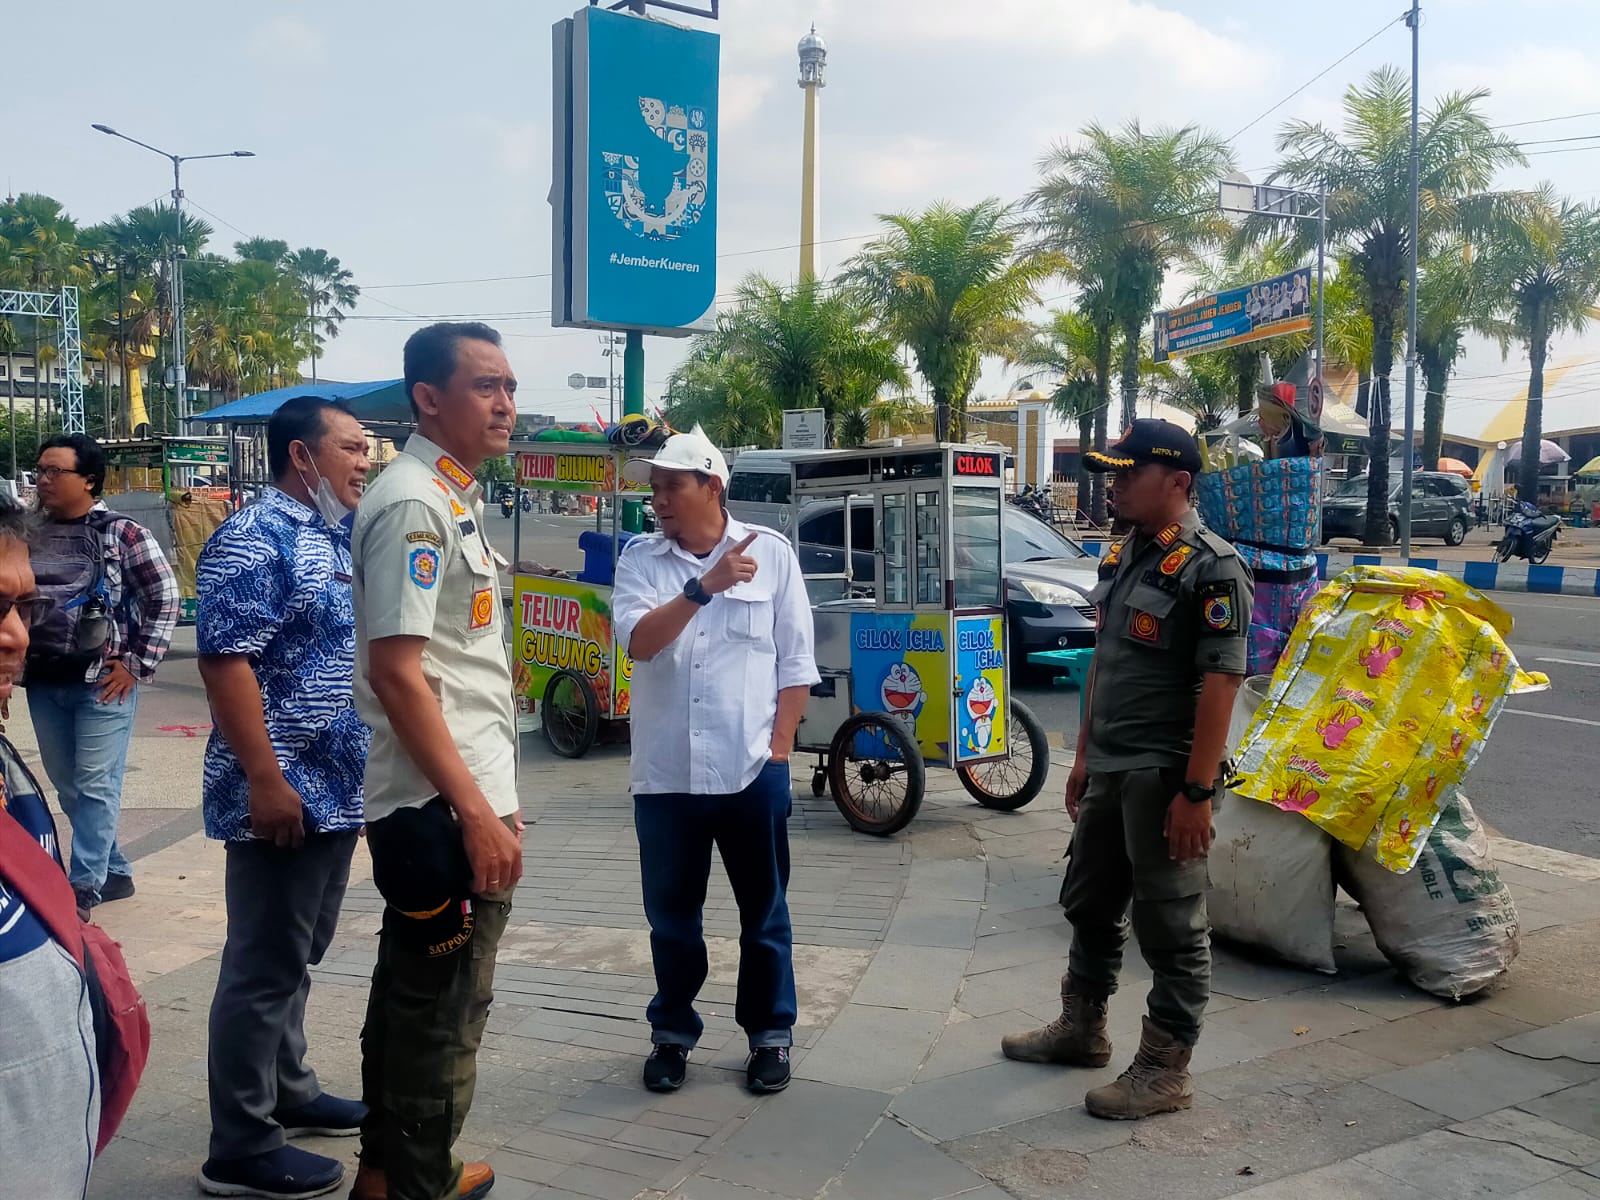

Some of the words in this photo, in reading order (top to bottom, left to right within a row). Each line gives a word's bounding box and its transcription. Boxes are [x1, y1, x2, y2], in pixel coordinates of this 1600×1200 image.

[609, 252, 700, 273] #JemberKueren
[522, 454, 556, 480] TELUR
[557, 455, 605, 483] GULUNG
[704, 458, 713, 470] 3
[957, 455, 994, 474] CILOK
[521, 593, 581, 634] TELUR
[856, 629, 902, 651] CILOK
[905, 630, 945, 652] ICHA
[958, 631, 994, 651] CILOK
[521, 629, 602, 678] GULUNG
[974, 650, 1004, 670] ICHA
[429, 933, 468, 954] SATPOL
